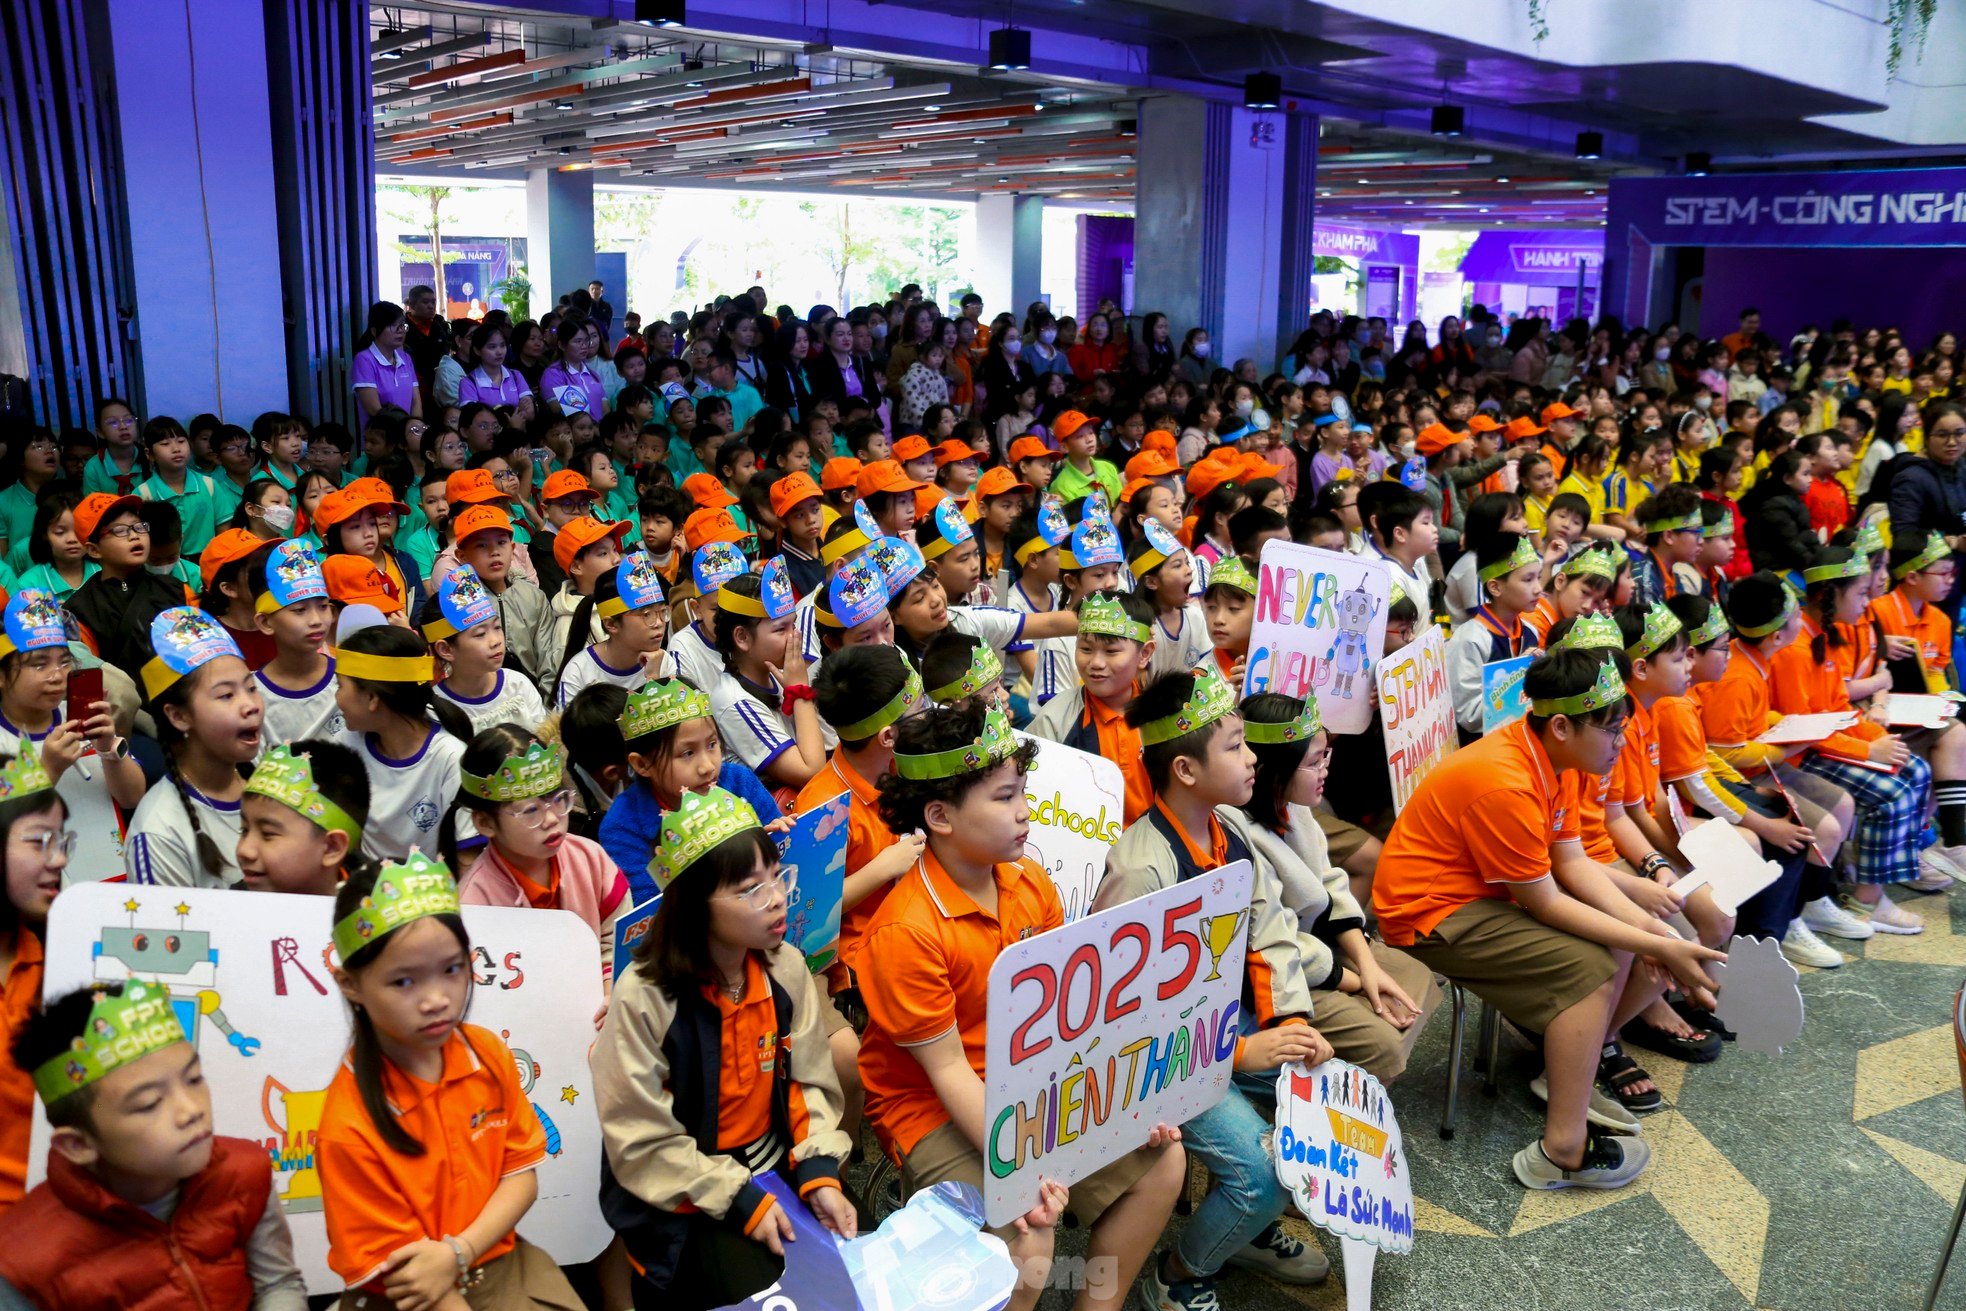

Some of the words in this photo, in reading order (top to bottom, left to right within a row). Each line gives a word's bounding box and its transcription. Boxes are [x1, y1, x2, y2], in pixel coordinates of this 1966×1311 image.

[1878, 192, 1966, 224] NGH
[1085, 608, 1110, 619] FPT
[1257, 564, 1338, 631] NEVER
[629, 703, 701, 734] SCHOOLS
[640, 693, 672, 715] FPT
[520, 759, 551, 780] FPT
[681, 802, 720, 835] FPT
[672, 811, 755, 867] SCHOOLS
[403, 874, 444, 894] FPT
[1010, 895, 1204, 1067] 2025
[120, 998, 166, 1030] FPT
[1280, 1125, 1327, 1168] Đoàn
[1339, 1113, 1376, 1155] Team
[1324, 1179, 1347, 1217] Là
